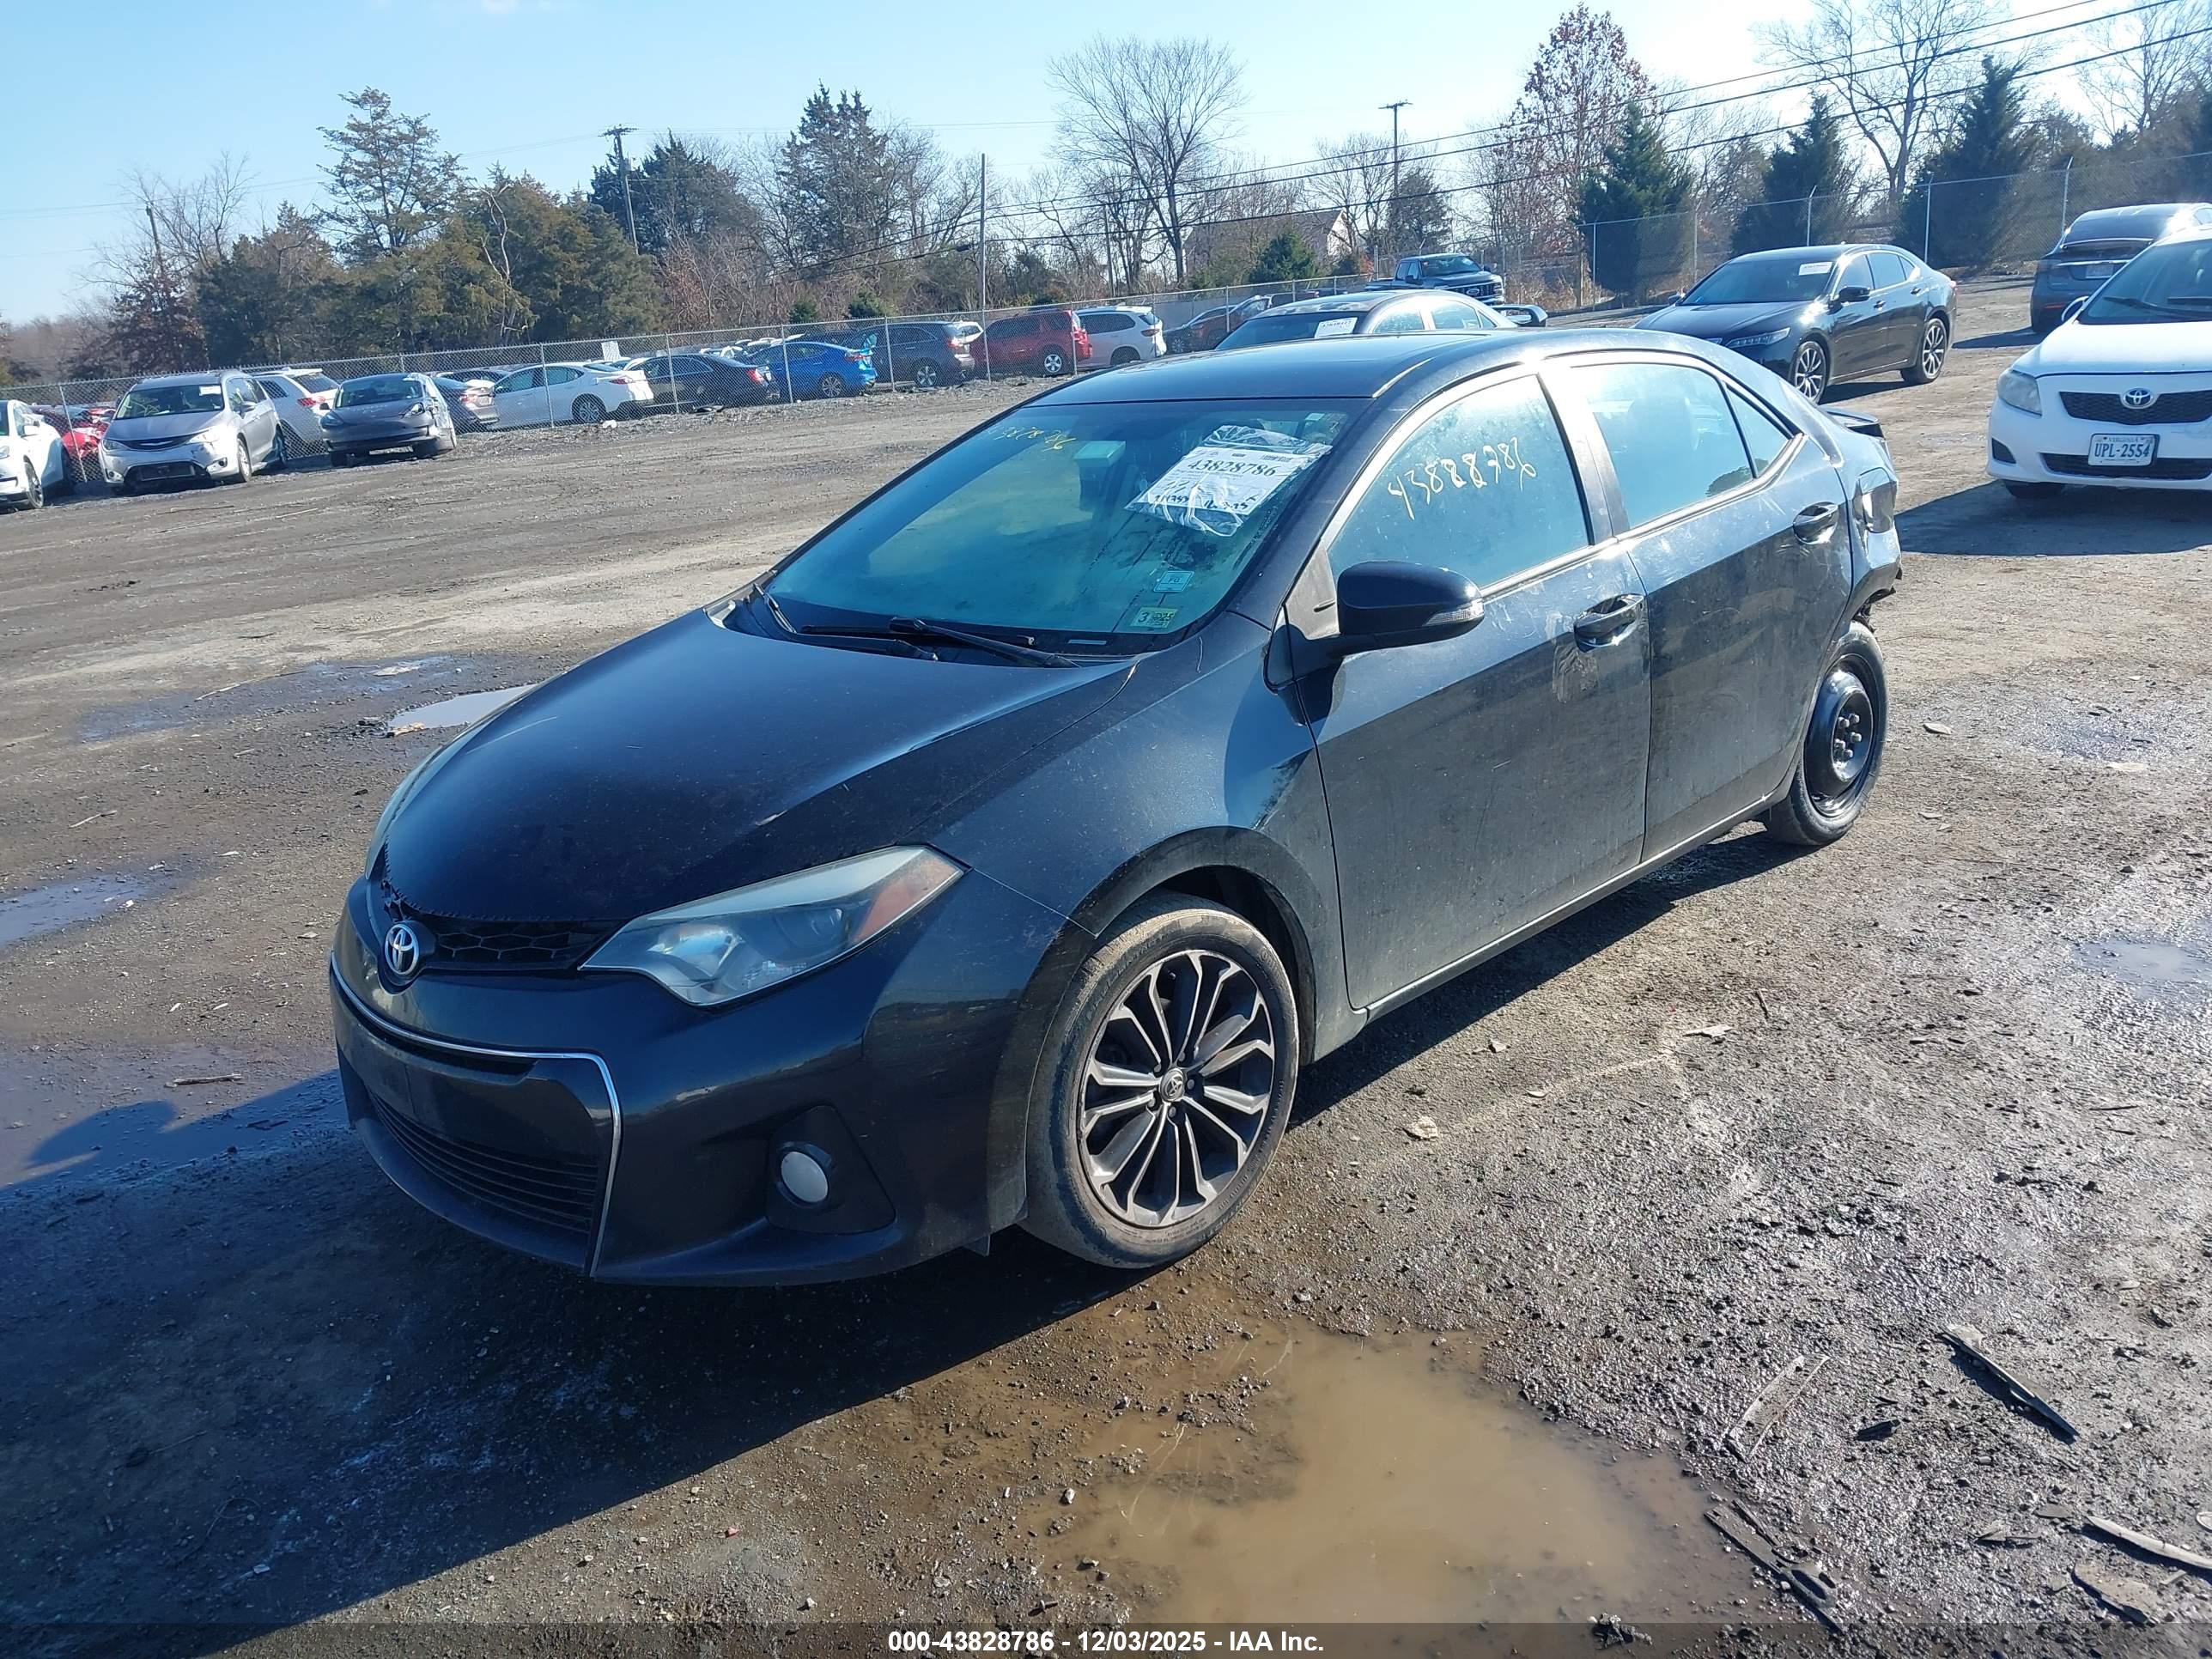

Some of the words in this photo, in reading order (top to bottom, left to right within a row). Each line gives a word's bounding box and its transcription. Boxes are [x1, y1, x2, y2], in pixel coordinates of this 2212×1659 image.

[2094, 443, 2151, 458] UPL-2554
[1188, 459, 1281, 477] 43828786
[1138, 611, 1149, 623] 3
